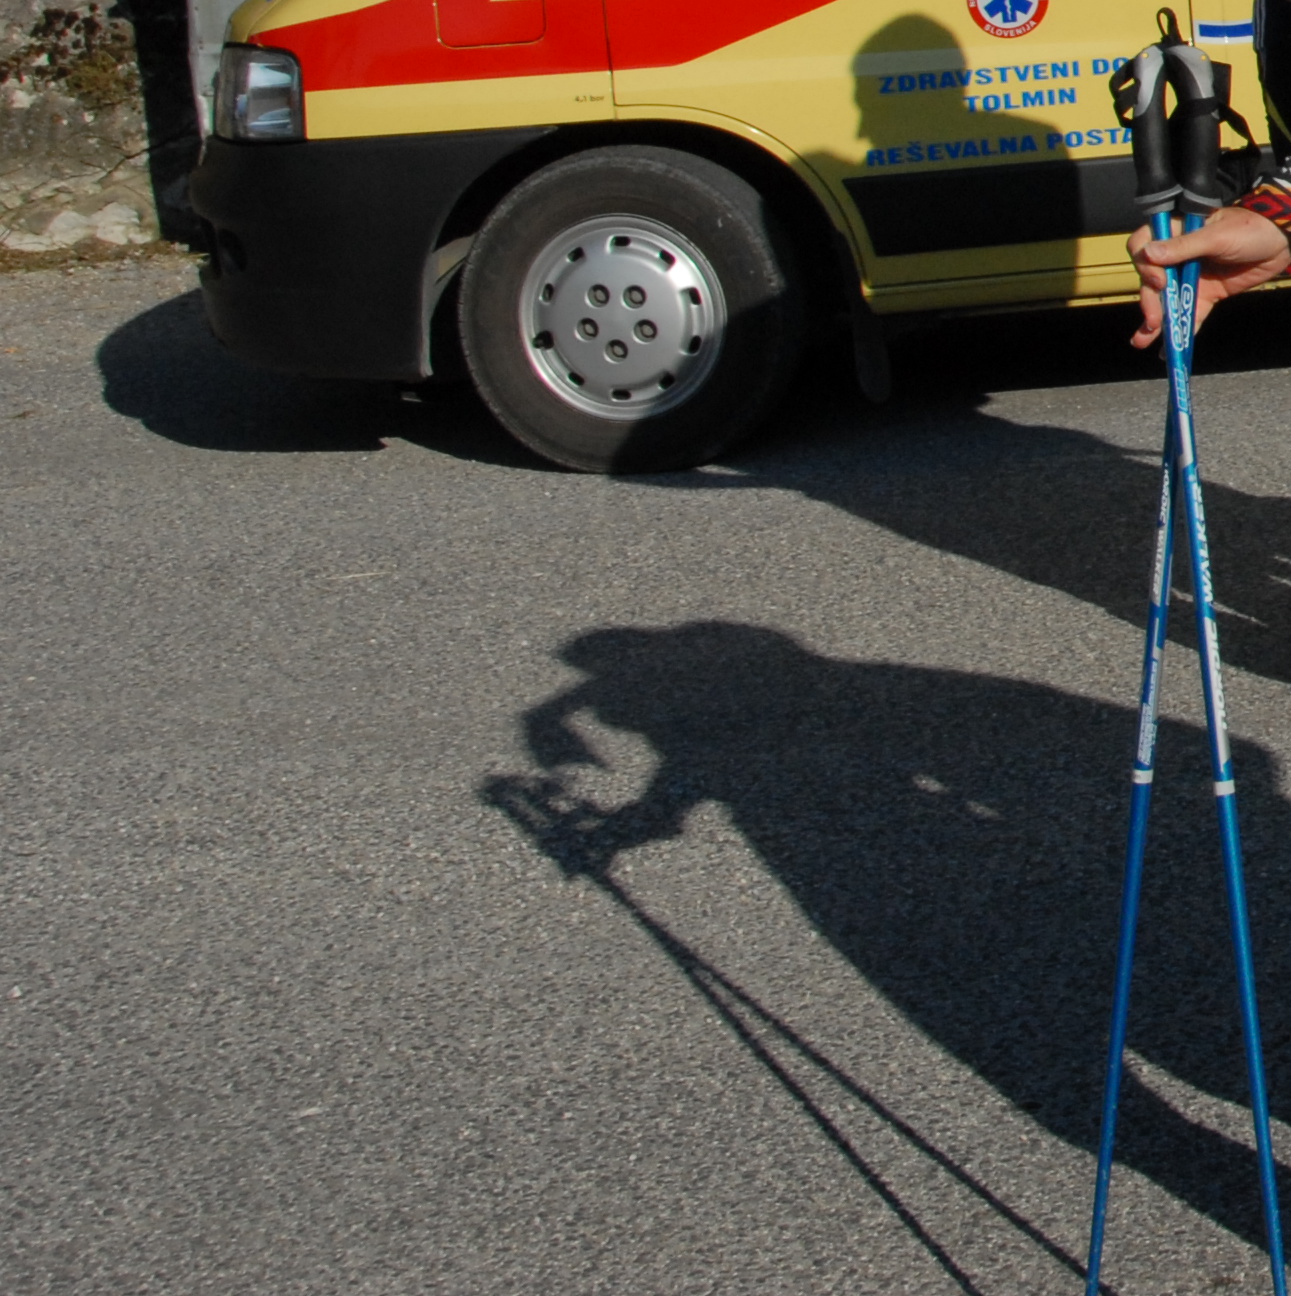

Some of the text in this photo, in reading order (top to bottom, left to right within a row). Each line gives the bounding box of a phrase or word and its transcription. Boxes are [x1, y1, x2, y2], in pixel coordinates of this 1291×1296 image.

[984, 19, 1037, 37] SLOVENIJA
[878, 59, 1080, 95] ZDRAVSTVENI
[965, 86, 1077, 114] TOLMIN
[866, 133, 1039, 167] REŠEVALNA
